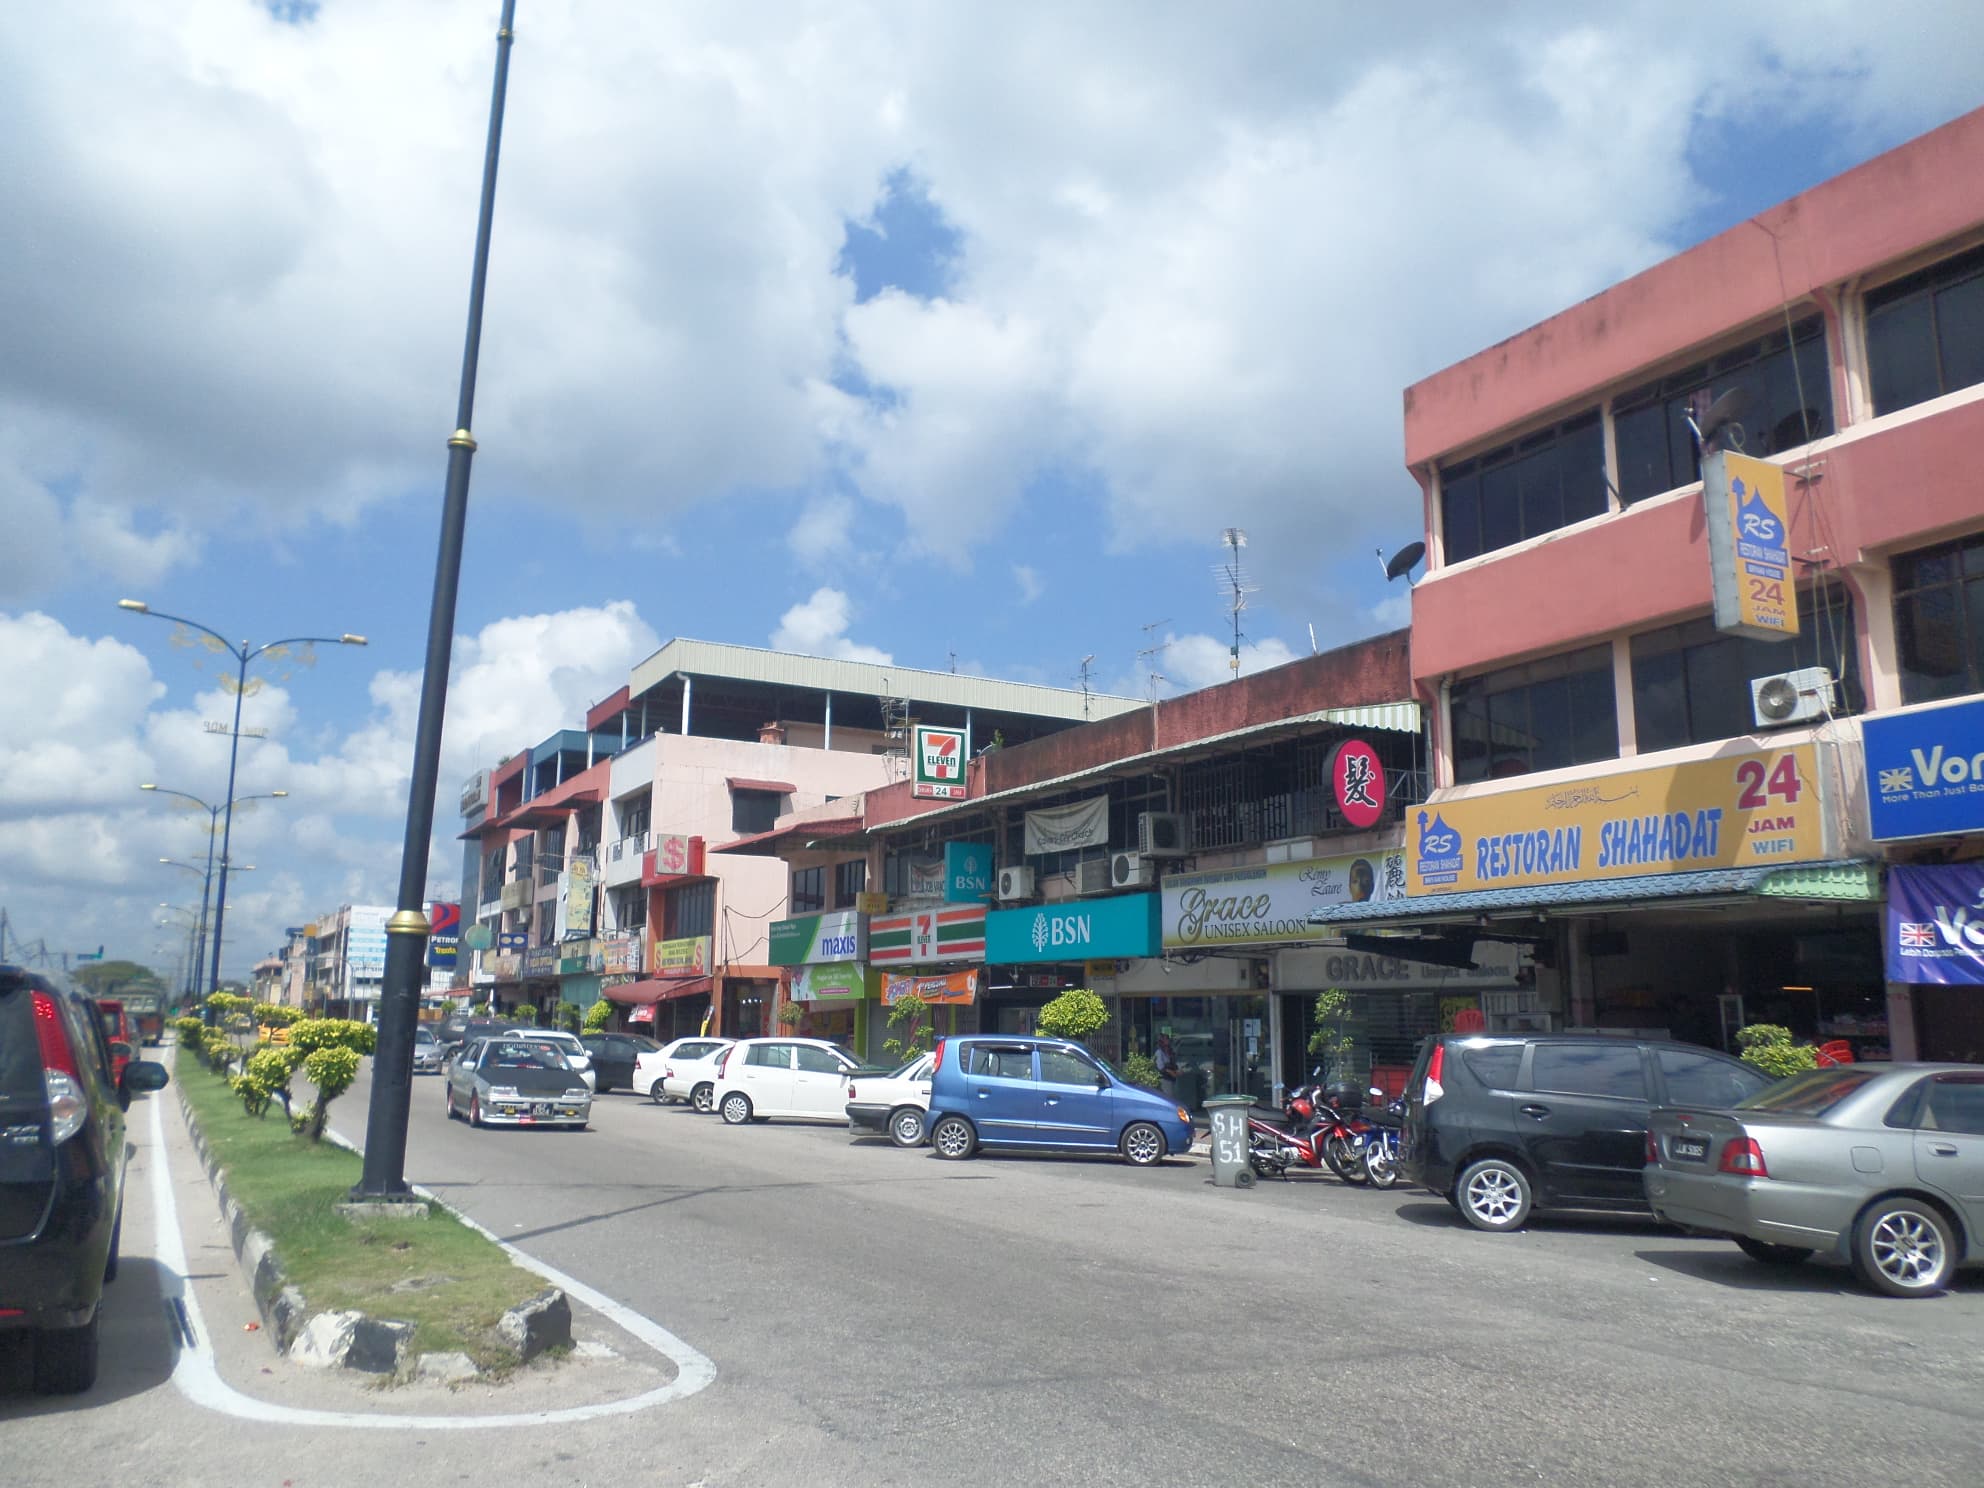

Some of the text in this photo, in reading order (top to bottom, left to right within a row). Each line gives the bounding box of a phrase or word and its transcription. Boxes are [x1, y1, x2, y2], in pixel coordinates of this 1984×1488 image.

[1743, 513, 1776, 540] RS
[1749, 578, 1785, 605] 24
[1752, 605, 1786, 616] JAM
[1755, 614, 1785, 627] WIFI
[927, 734, 956, 779] 7
[935, 787, 947, 796] 24
[1736, 753, 1801, 810] 24
[1882, 794, 1909, 804] More
[1913, 790, 1940, 799] Than
[1944, 786, 1966, 796] Just
[1748, 816, 1795, 833] JAM
[1425, 835, 1453, 855] RS
[1476, 808, 1723, 881] RESTORAN SHAHADAT
[1752, 839, 1793, 854] WIFI
[955, 876, 986, 890] BSN
[1178, 887, 1271, 944] Grace
[917, 915, 931, 956] 7
[1051, 914, 1090, 945] BSN
[1205, 918, 1306, 939] UNISEX SALOON
[822, 936, 856, 955] maxis
[1326, 955, 1410, 982] GRACE
[1220, 1140, 1244, 1163] 51
